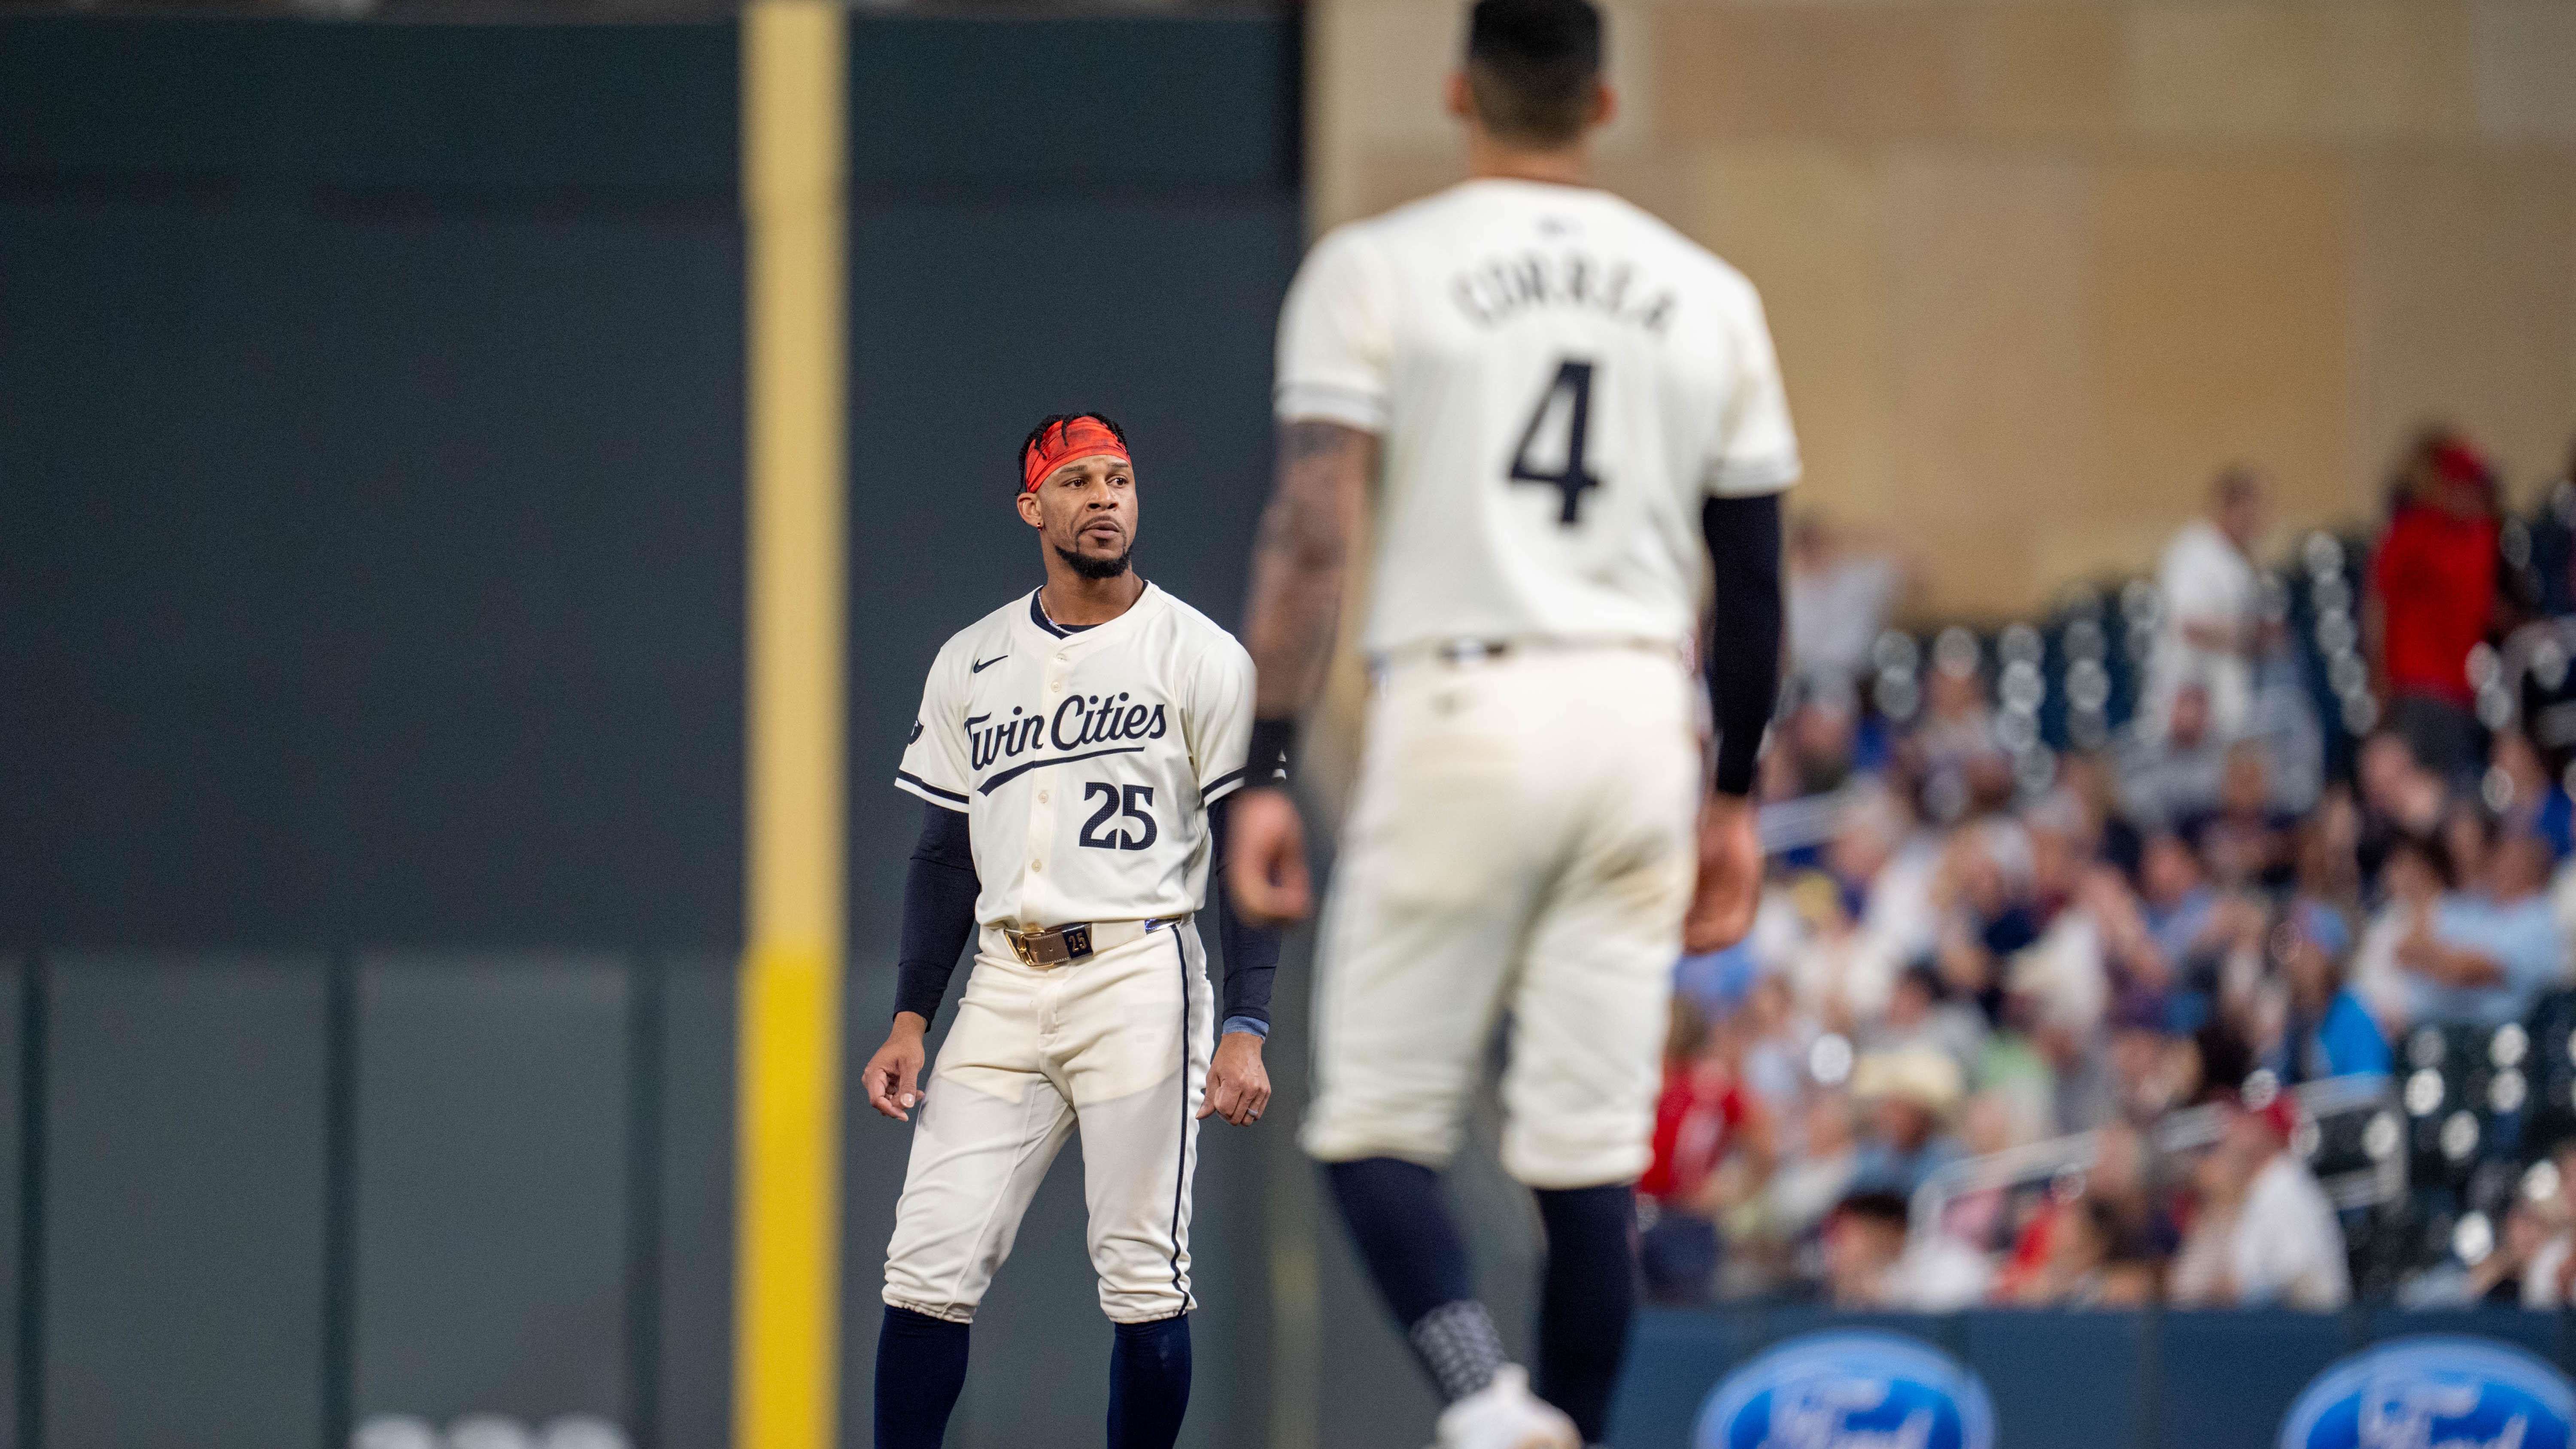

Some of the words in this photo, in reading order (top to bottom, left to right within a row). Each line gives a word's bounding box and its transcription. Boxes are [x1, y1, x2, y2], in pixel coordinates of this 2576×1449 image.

[1508, 360, 1601, 525] 4
[964, 706, 1045, 771] Twin
[1051, 692, 1167, 751] Cities
[1079, 782, 1157, 851] 25
[1068, 932, 1087, 952] 25
